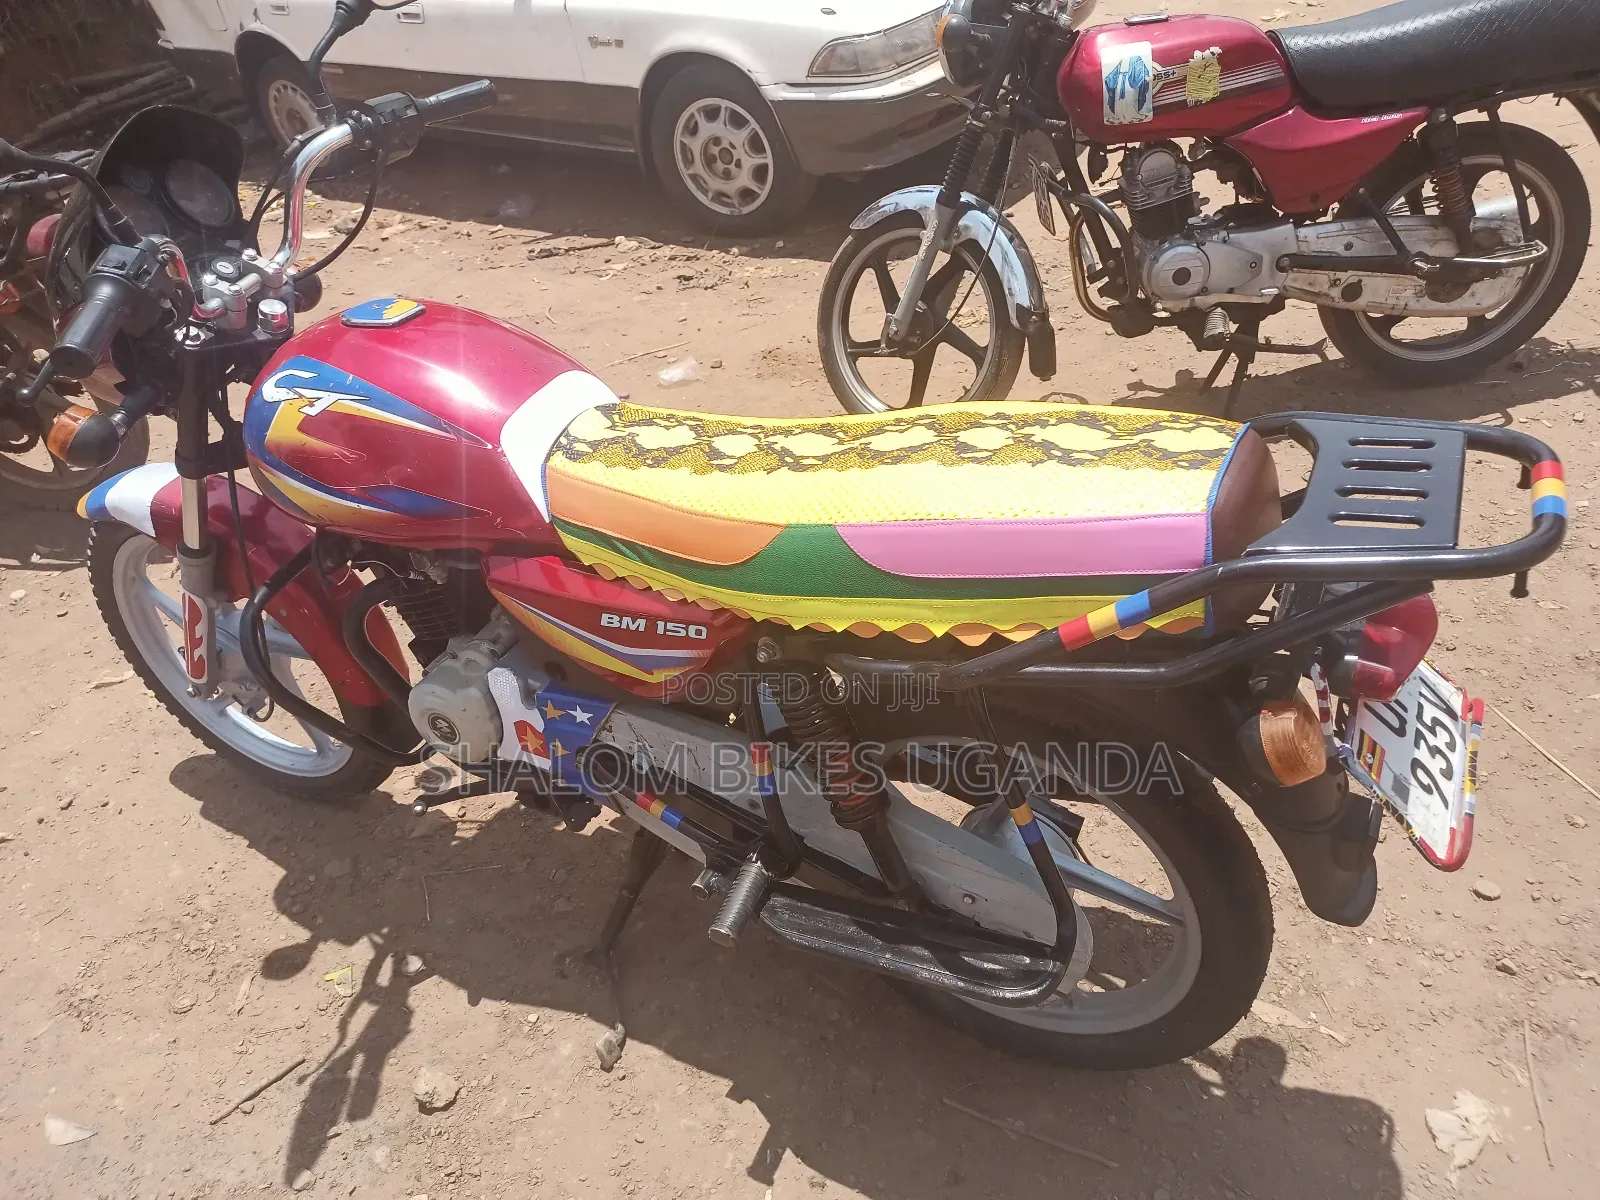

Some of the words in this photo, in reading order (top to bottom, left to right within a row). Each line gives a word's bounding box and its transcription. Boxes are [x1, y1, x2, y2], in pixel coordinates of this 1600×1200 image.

[600, 613, 647, 632] BM
[656, 620, 708, 640] 150
[1410, 675, 1459, 811] 935V
